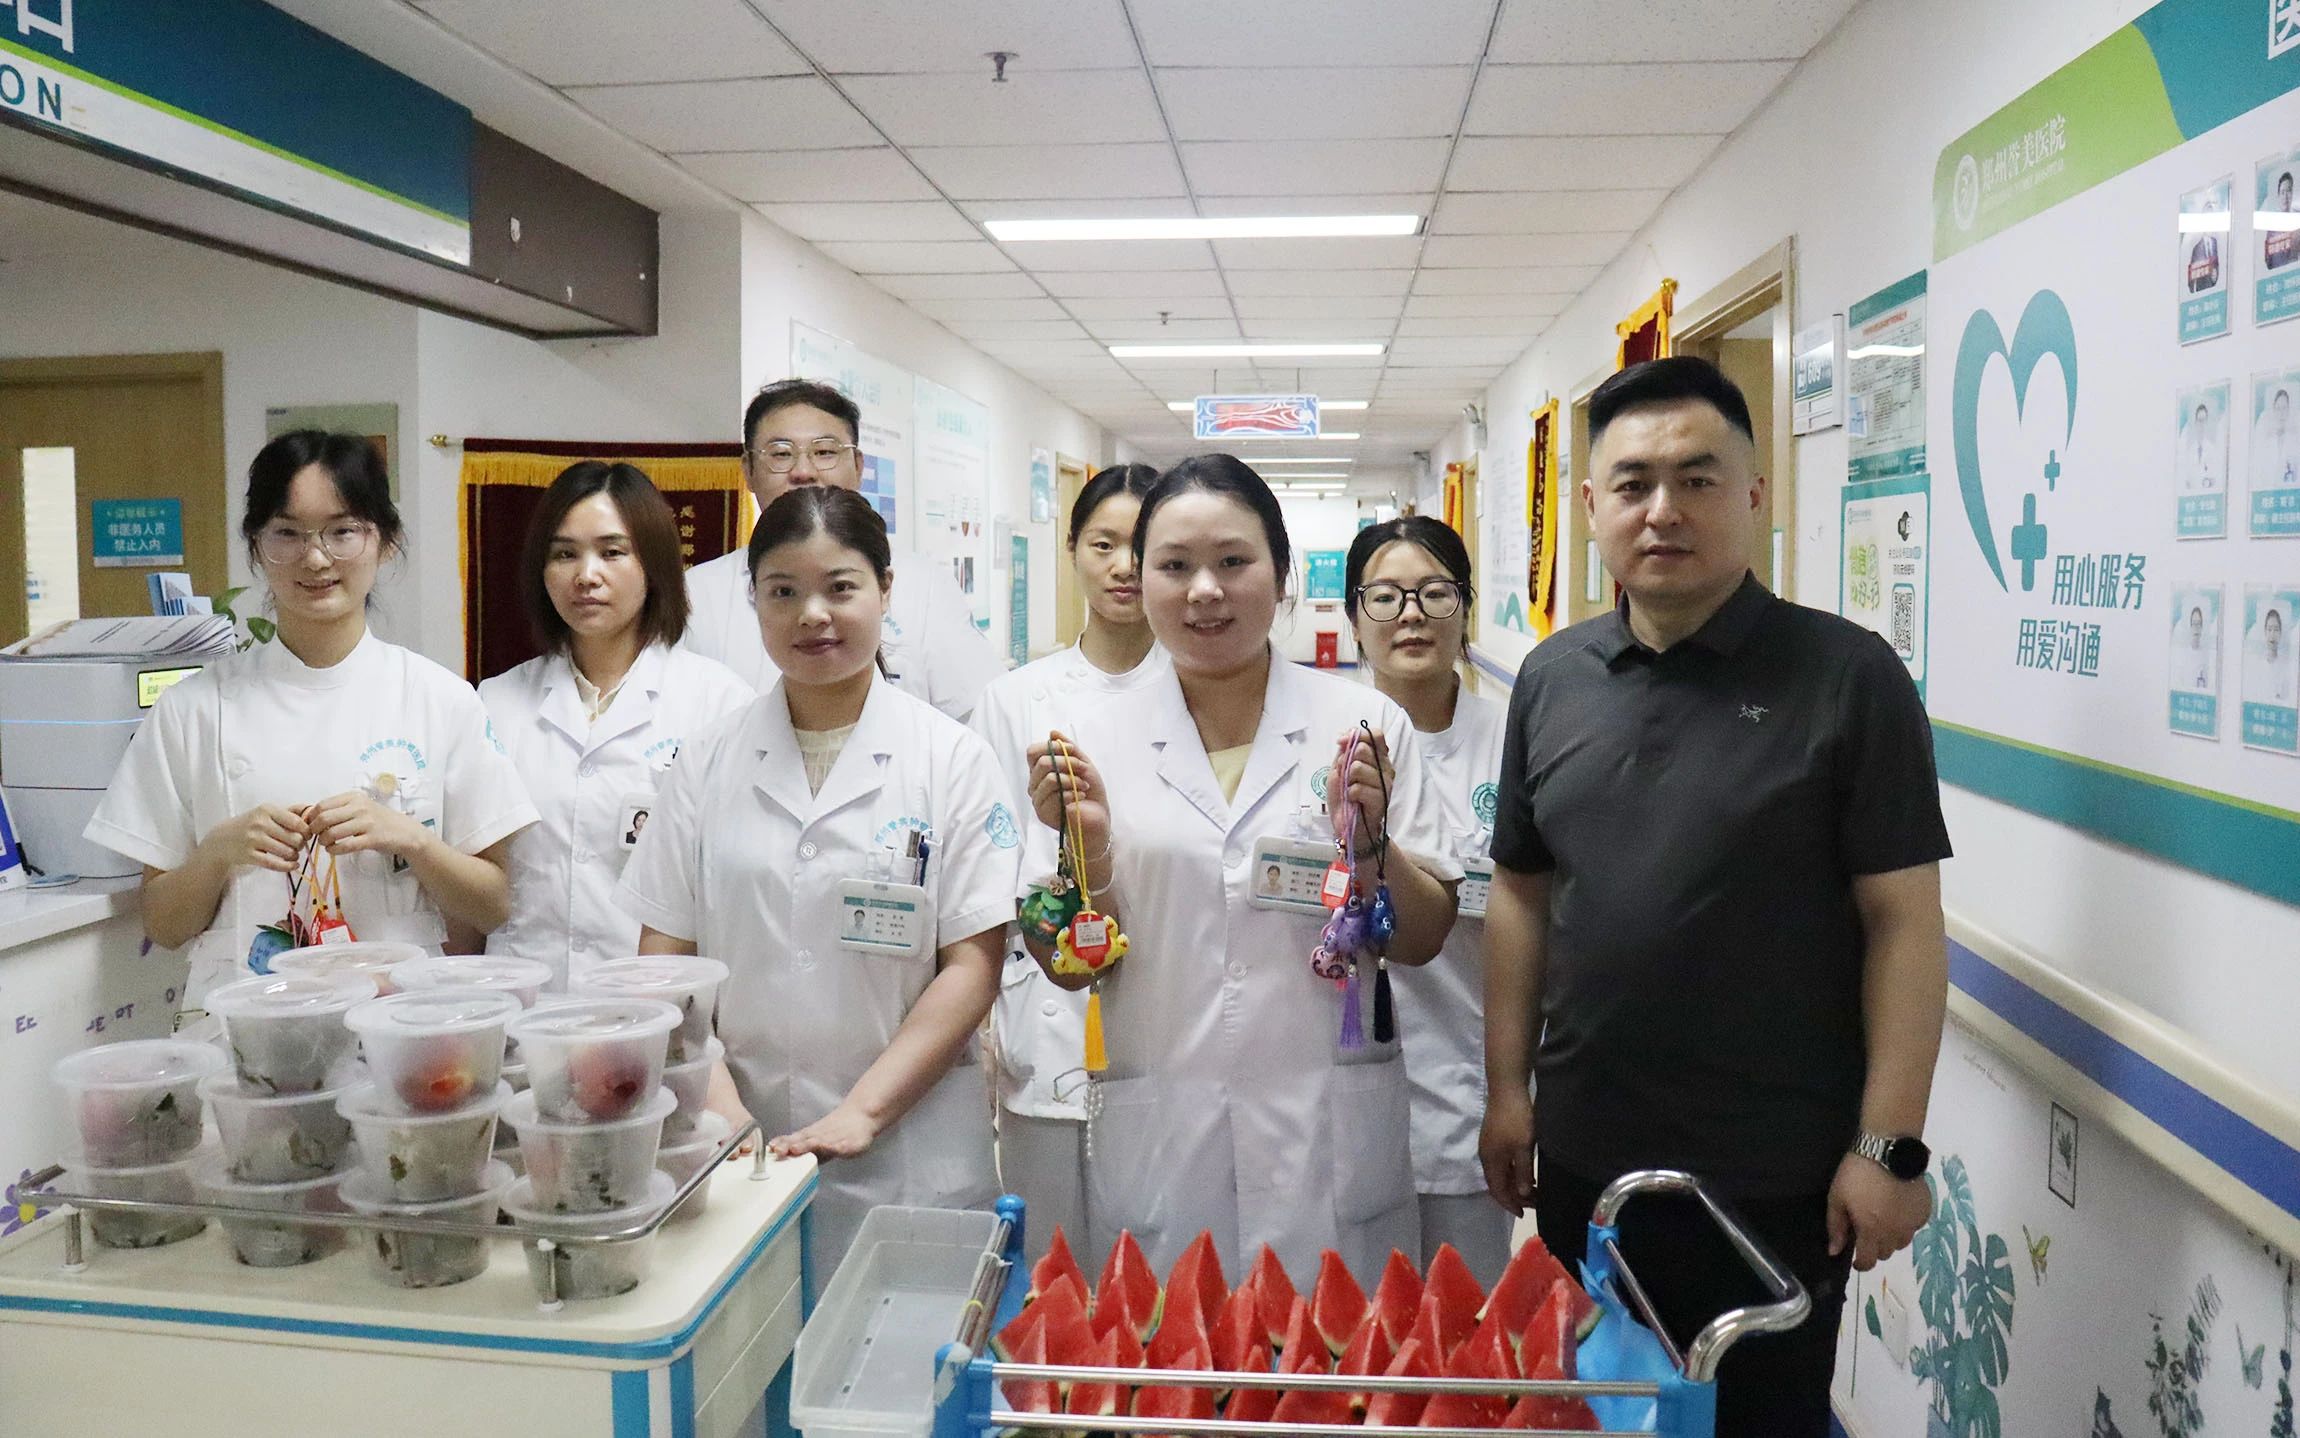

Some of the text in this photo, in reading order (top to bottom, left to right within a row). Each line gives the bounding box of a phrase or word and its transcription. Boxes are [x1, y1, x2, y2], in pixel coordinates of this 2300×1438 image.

[114, 538, 161, 552] 禁止入内
[2052, 553, 2146, 609] 用心服务
[2016, 618, 2101, 677] 用爱沟通
